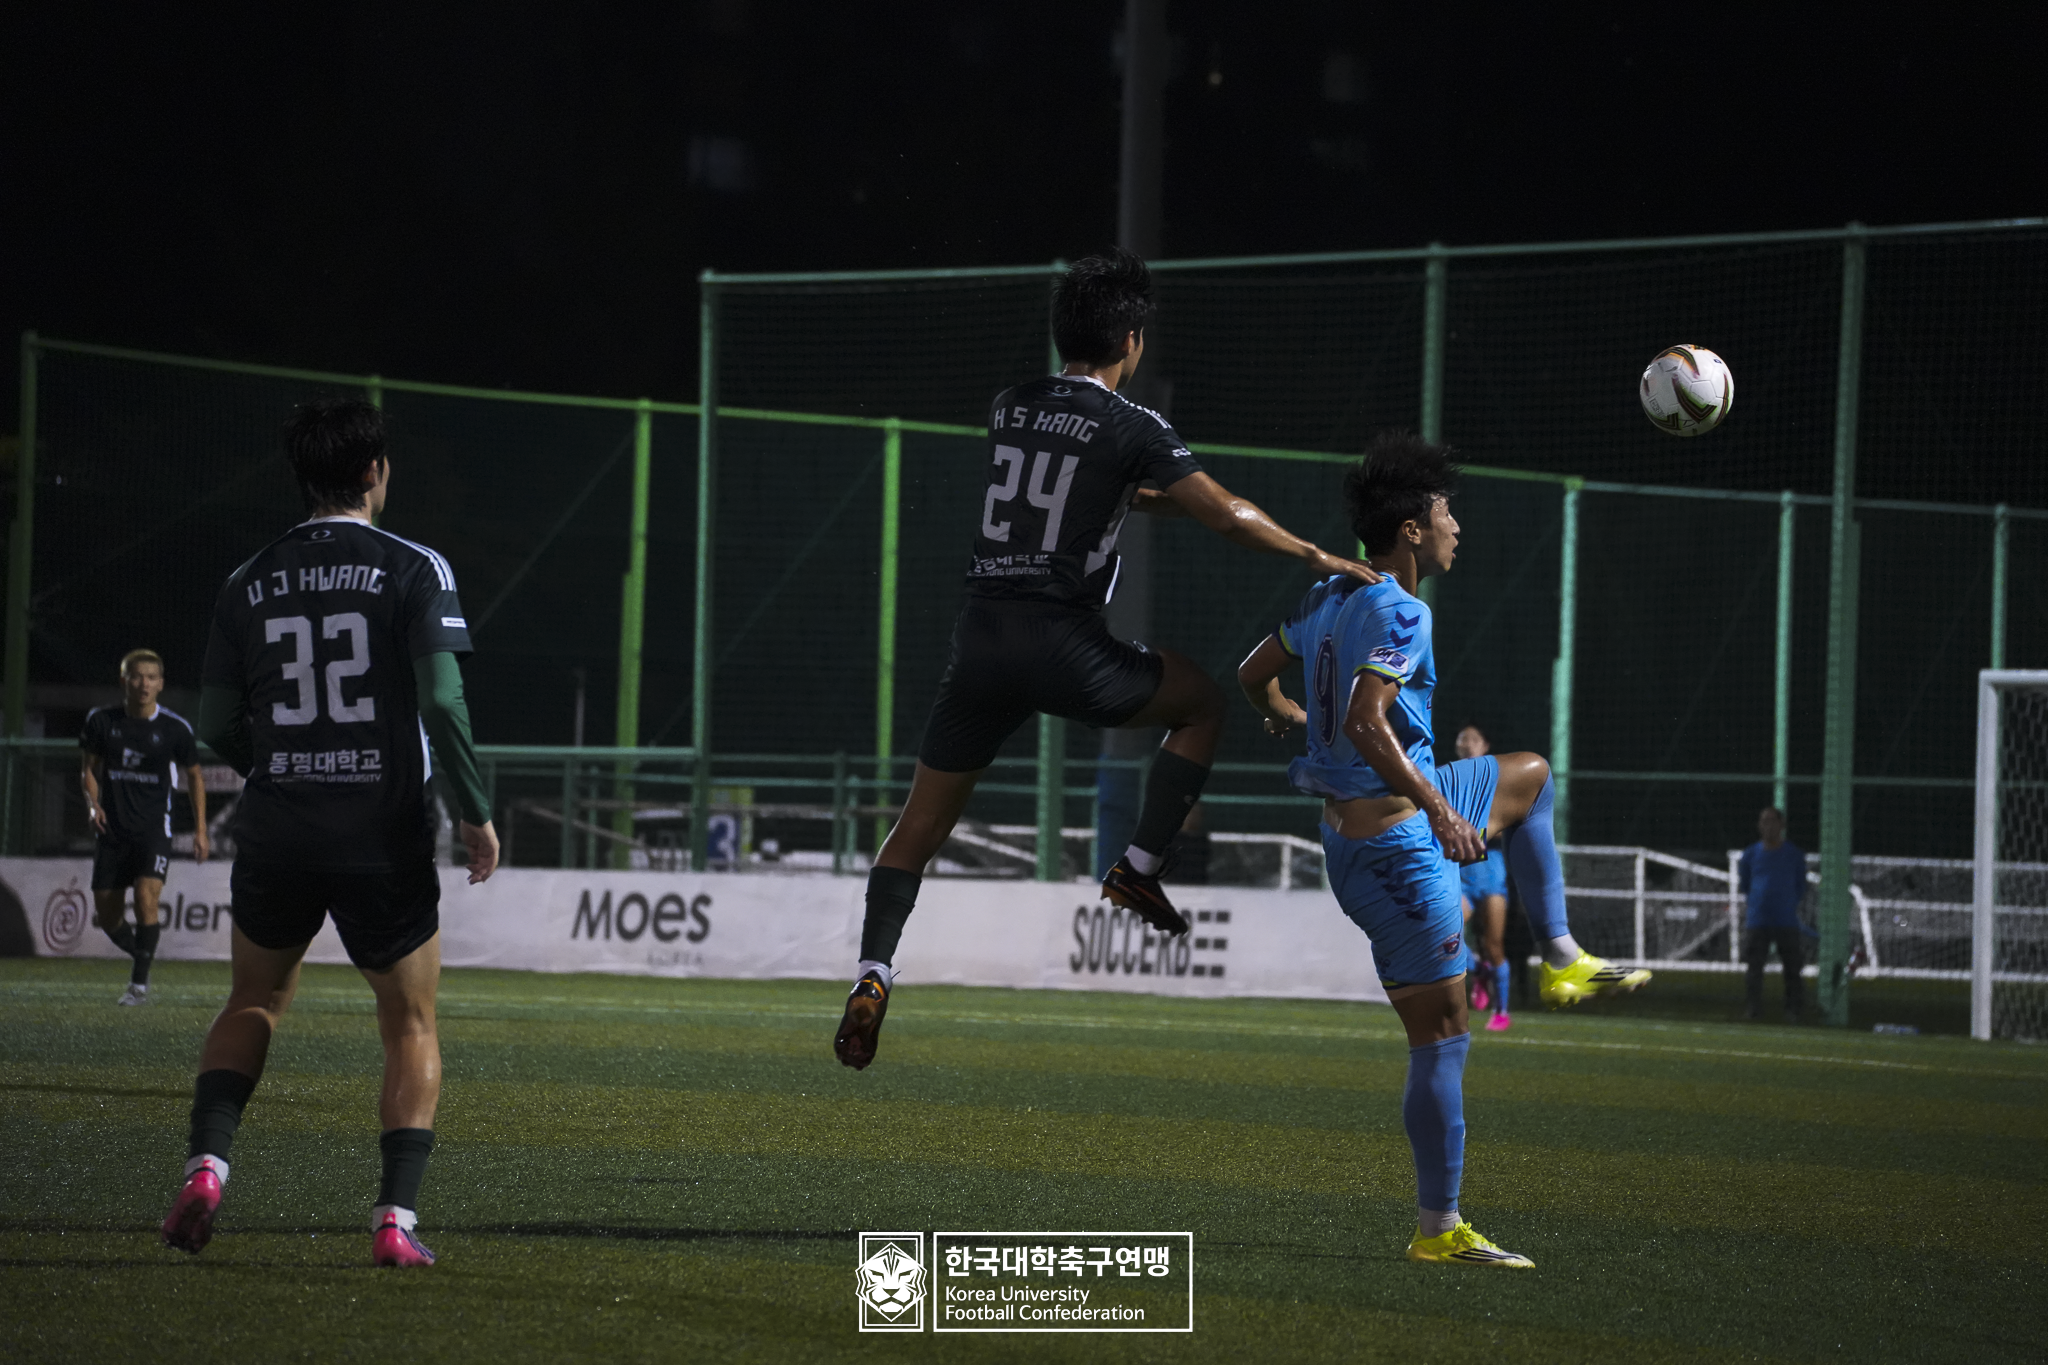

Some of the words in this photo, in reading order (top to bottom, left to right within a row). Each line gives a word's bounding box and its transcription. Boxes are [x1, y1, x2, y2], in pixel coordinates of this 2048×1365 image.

[1011, 406, 1028, 428] S
[1033, 411, 1100, 444] KANG
[981, 444, 1080, 552] 24
[271, 570, 289, 596] J
[299, 565, 387, 595] HWANG
[265, 612, 375, 726] 32
[1314, 634, 1338, 748] 9
[268, 749, 382, 775] 동명대학교
[154, 854, 167, 875] 12
